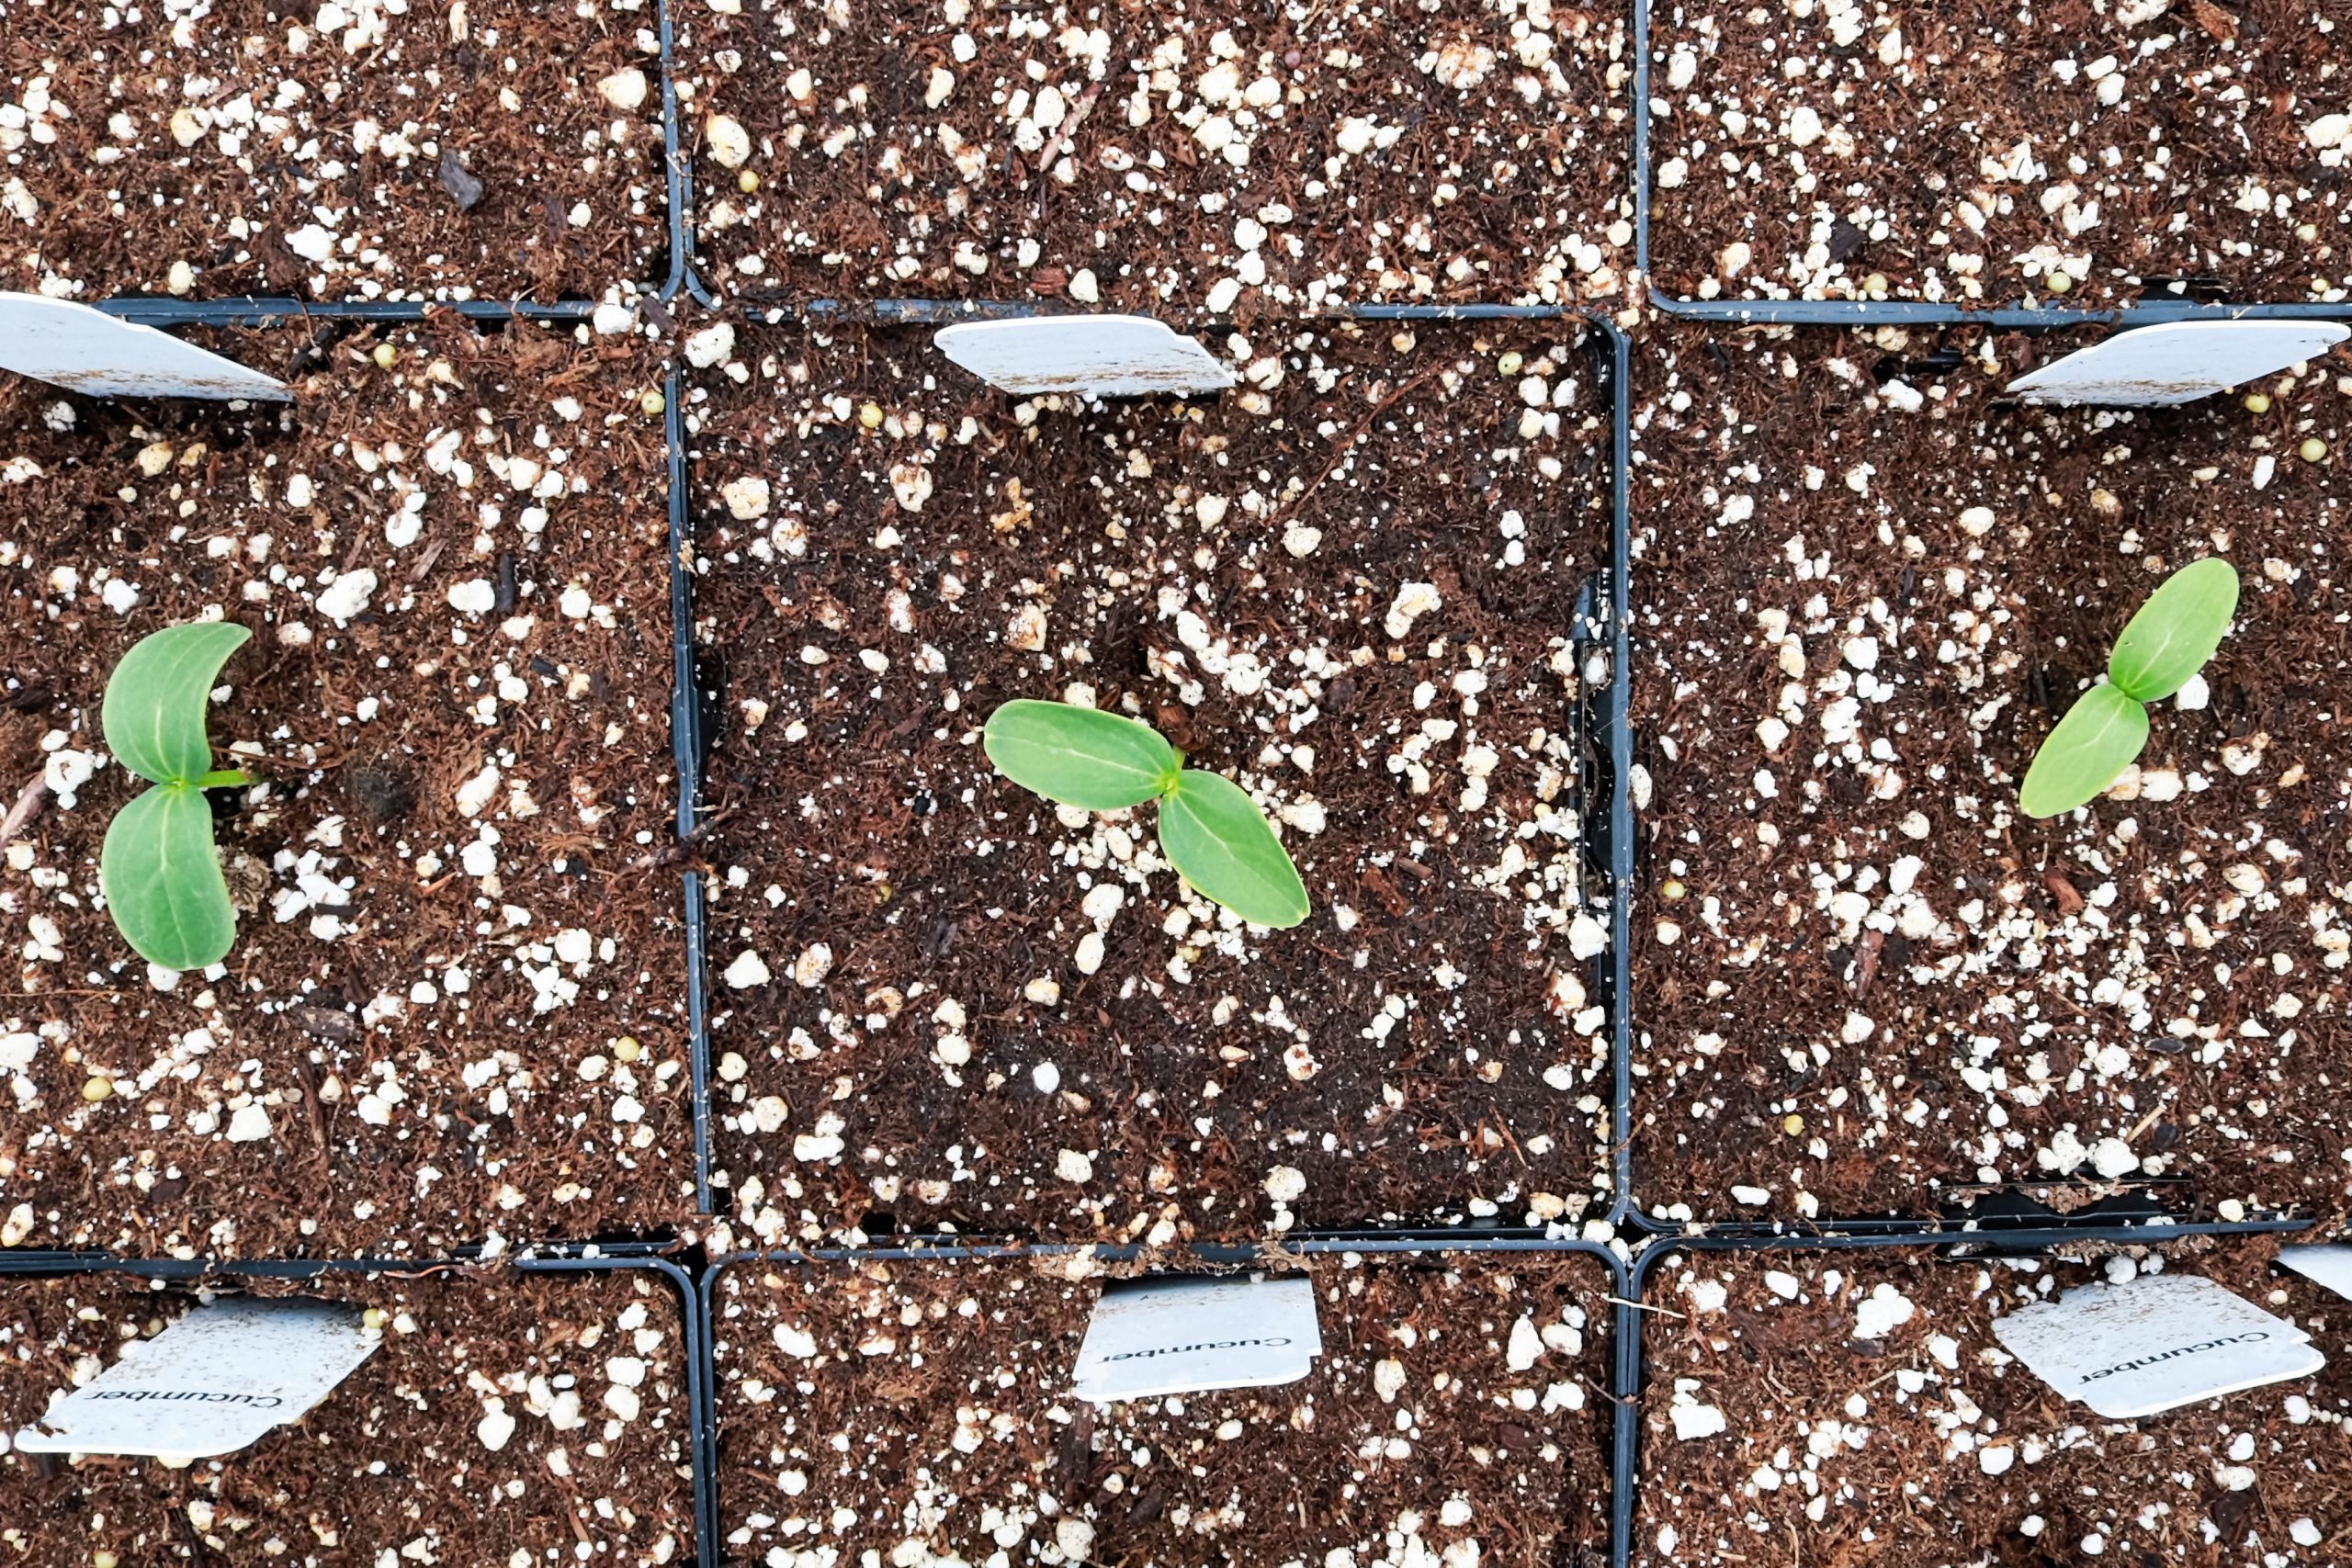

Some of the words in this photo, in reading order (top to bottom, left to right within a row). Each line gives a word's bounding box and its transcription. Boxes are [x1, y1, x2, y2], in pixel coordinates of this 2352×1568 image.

[1095, 1337, 1291, 1363] Cucumber
[2078, 1331, 2269, 1384] Cucumber
[85, 1391, 282, 1408] Cucumber
